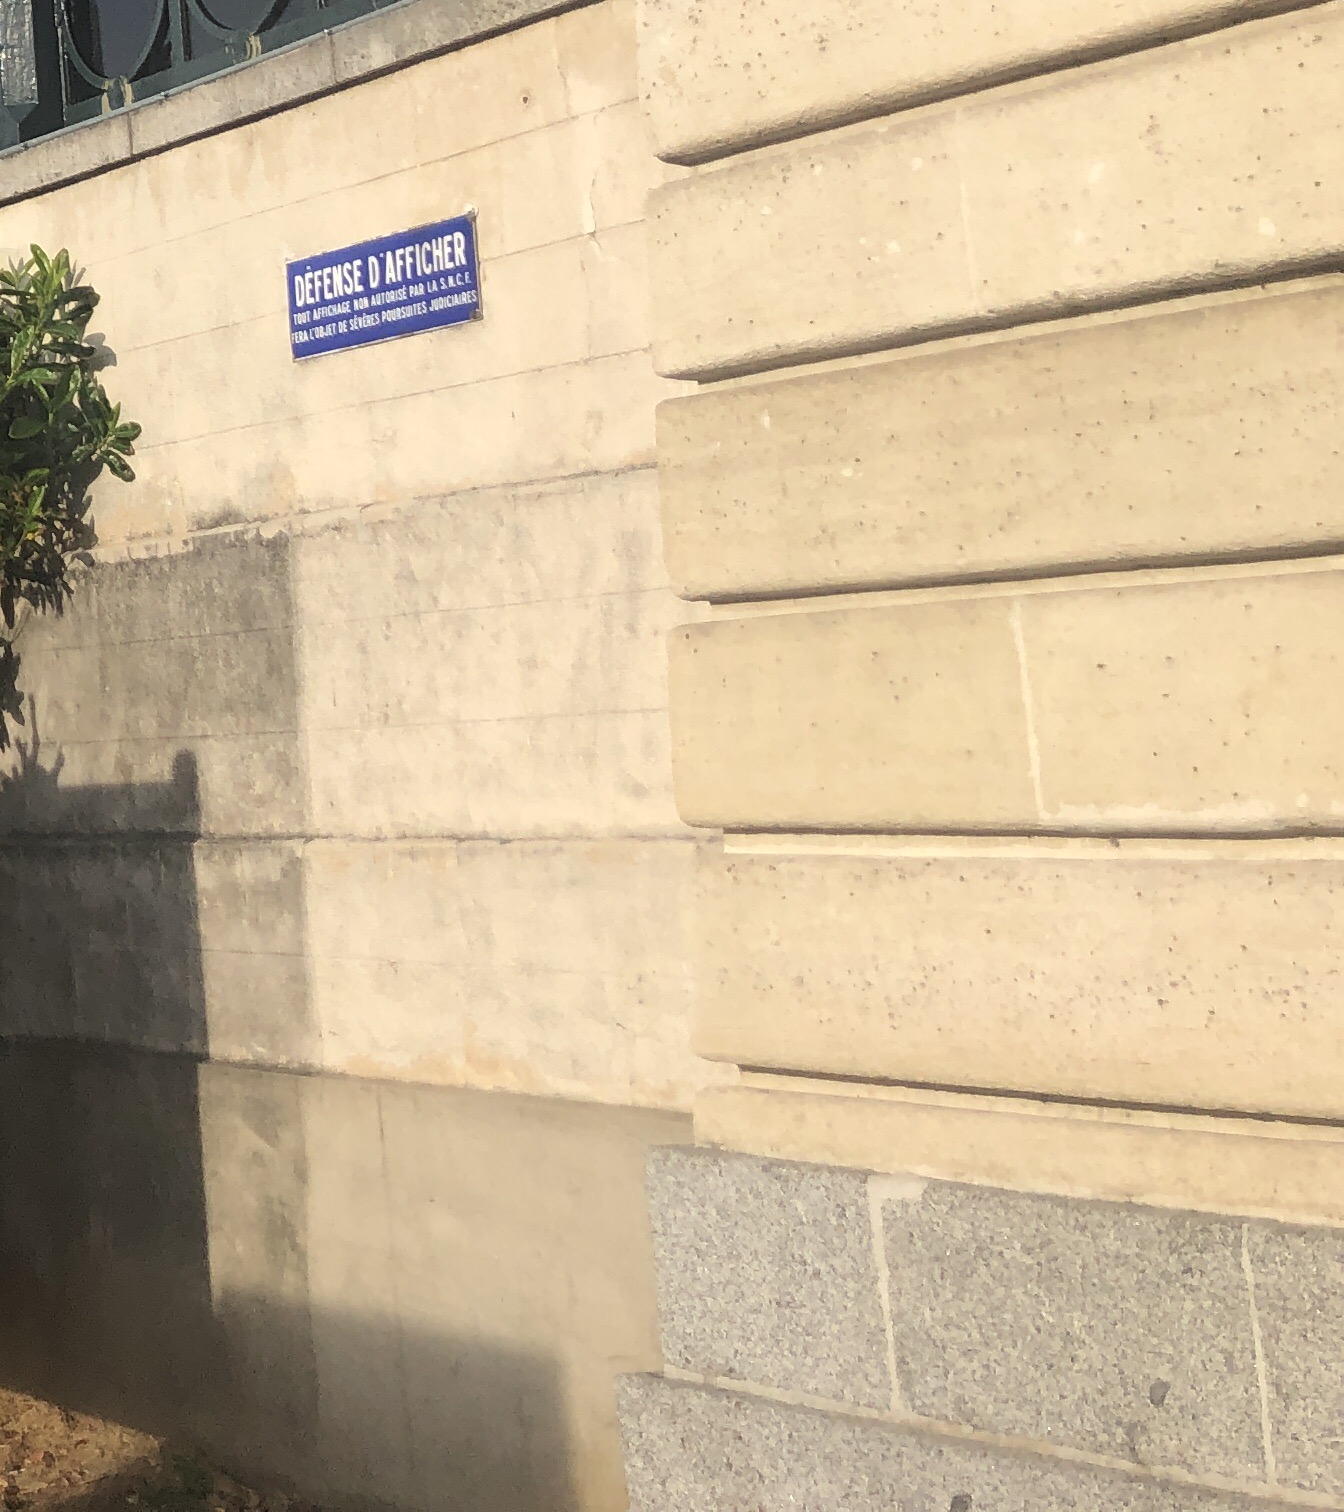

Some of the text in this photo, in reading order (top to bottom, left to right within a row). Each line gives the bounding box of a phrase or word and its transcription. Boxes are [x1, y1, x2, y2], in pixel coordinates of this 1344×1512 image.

[293, 310, 311, 325] TOUT
[313, 300, 352, 321] AFFICHAGE
[353, 296, 369, 311] NON
[409, 282, 426, 298] PAR
[427, 279, 439, 293] LA
[294, 258, 365, 307] DÉFENSE
[338, 319, 348, 334] DE
[381, 300, 428, 322] POURSUITES
[429, 290, 477, 312] JUDICIAIRES
